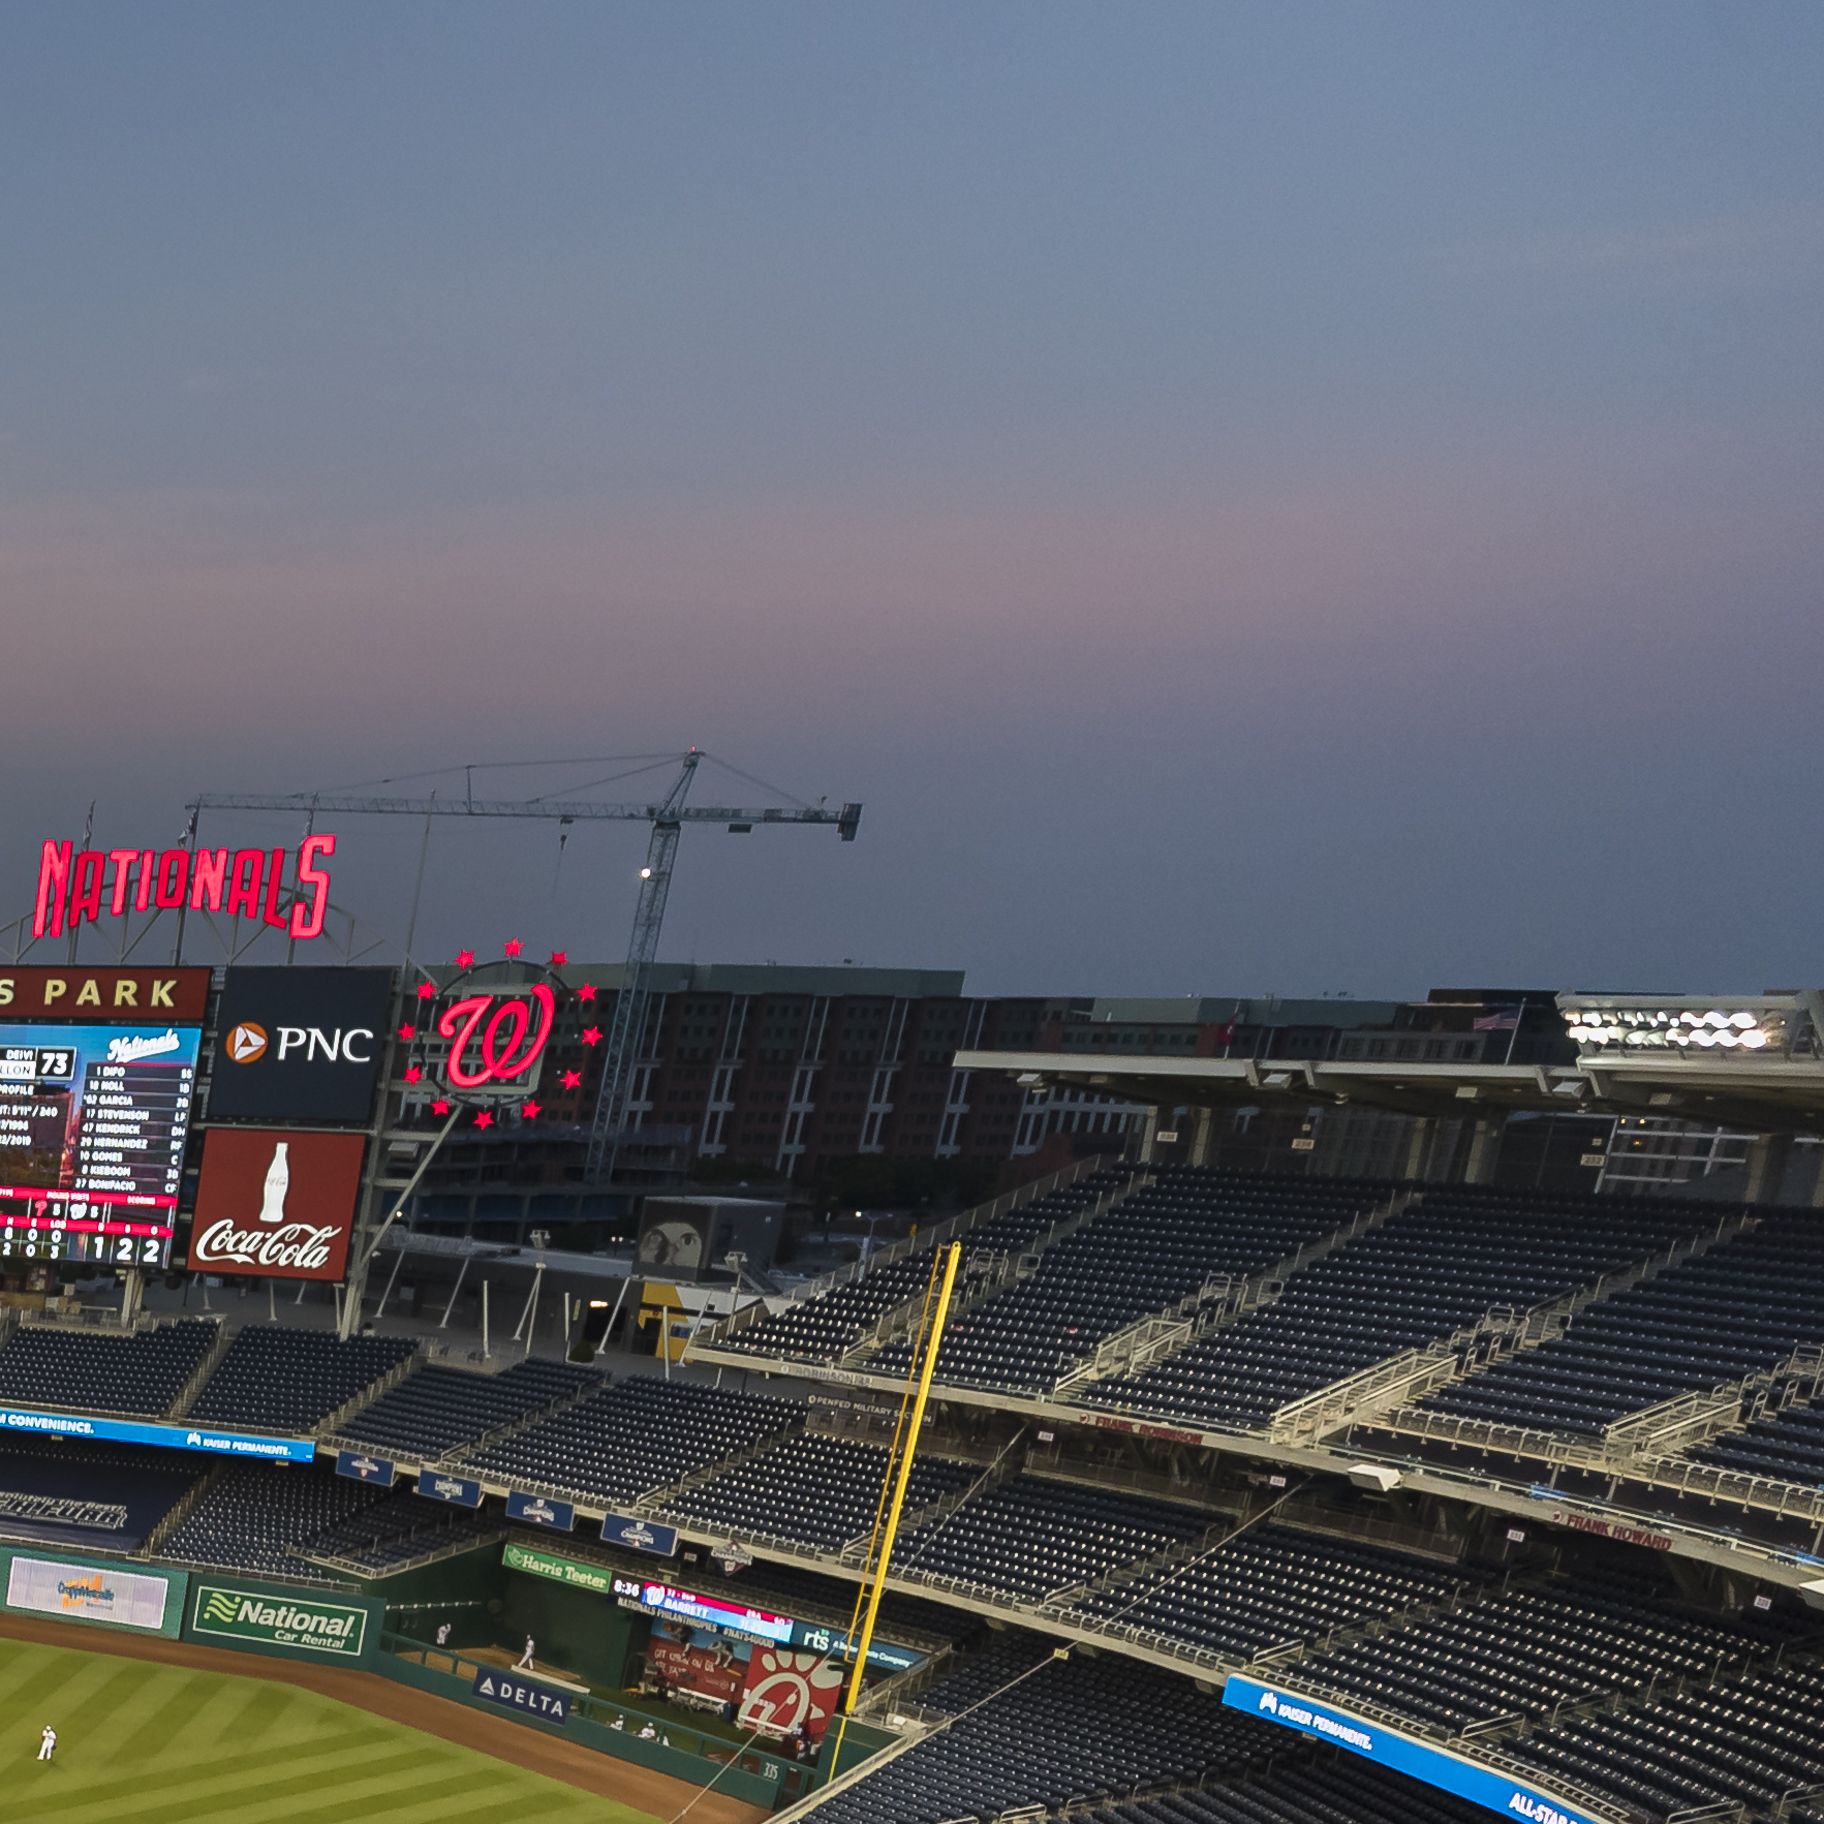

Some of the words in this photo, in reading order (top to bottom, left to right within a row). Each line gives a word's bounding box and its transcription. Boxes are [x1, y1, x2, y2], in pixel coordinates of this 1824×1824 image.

[33, 834, 336, 939] NATIONALS
[43, 979, 178, 1008] PARK
[107, 1028, 180, 1063] Nationals
[277, 1027, 375, 1062] PNC
[439, 983, 555, 1088] W
[41, 1053, 67, 1074] 73
[195, 1218, 342, 1269] Coca-Cola
[817, 1395, 851, 1409] PENFED
[853, 1402, 893, 1417] MILITARY
[8, 1414, 95, 1434] CONVENIENCE.
[203, 1437, 231, 1450] KAISER
[1567, 1514, 1610, 1534] FRANK
[1613, 1524, 1673, 1550] HOWARD
[522, 1554, 563, 1577] Harris
[563, 1564, 608, 1589] Teeter
[614, 1580, 640, 1597] 8:36
[237, 1600, 354, 1637] National
[617, 1596, 656, 1616] NATIONALS
[274, 1629, 299, 1642] Car
[301, 1634, 346, 1650] Rental
[804, 1631, 829, 1651] rts
[499, 1683, 563, 1717] DELTA
[1278, 1702, 1312, 1727] KAISER
[763, 1762, 779, 1781] 335
